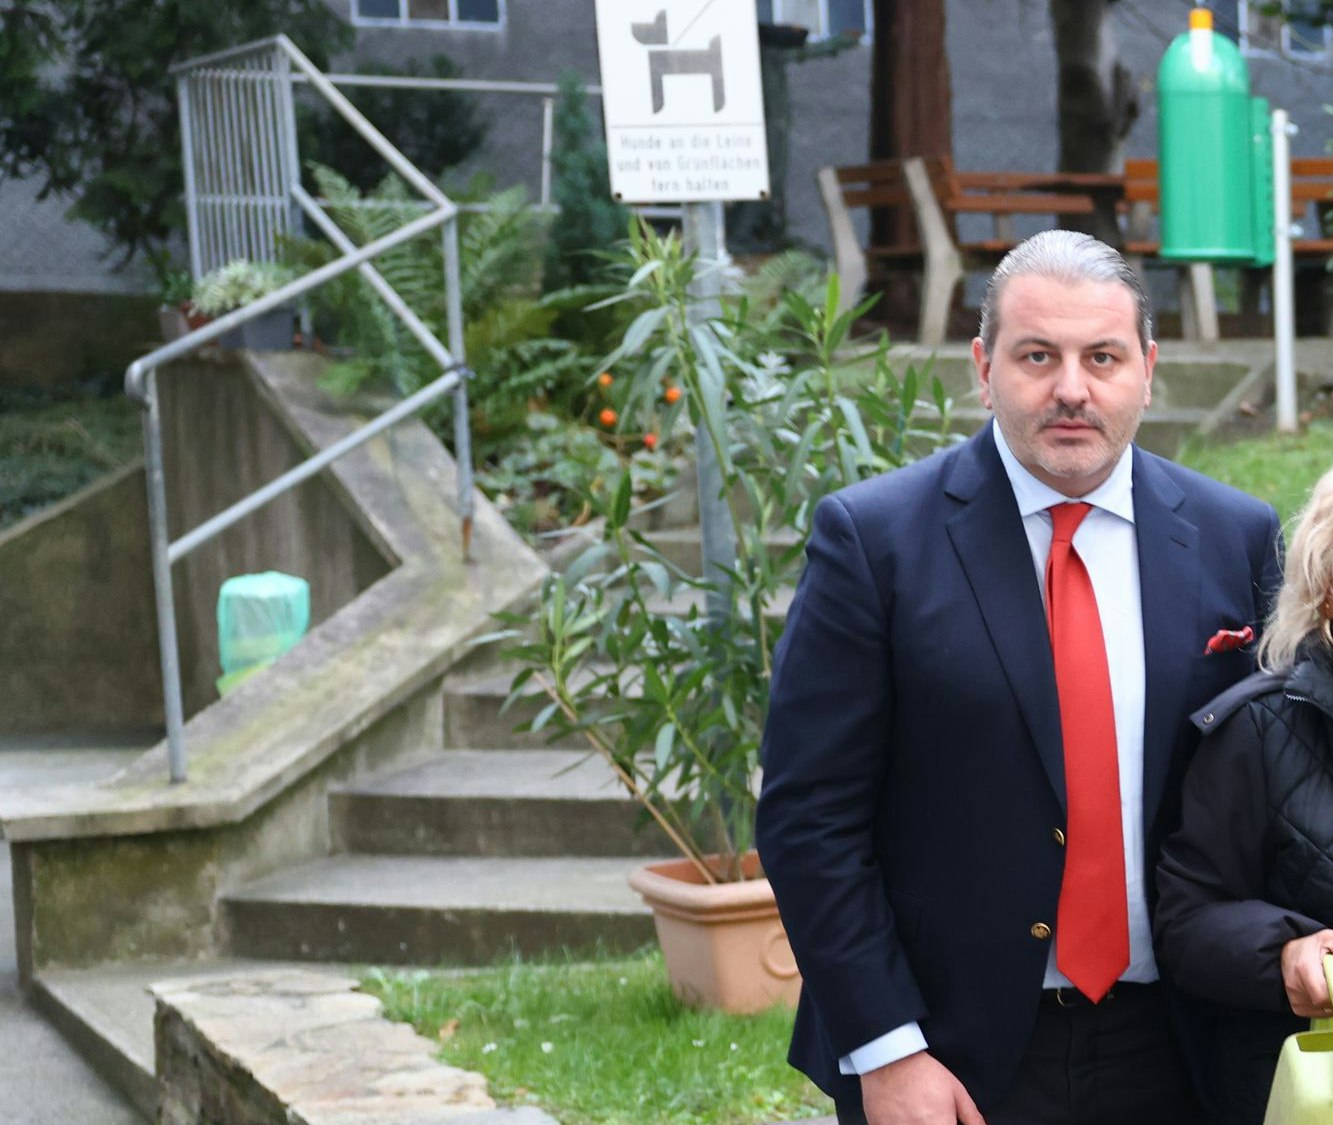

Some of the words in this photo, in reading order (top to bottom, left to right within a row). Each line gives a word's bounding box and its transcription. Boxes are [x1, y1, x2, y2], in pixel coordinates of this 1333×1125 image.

[620, 135, 661, 151] Hunde
[670, 138, 685, 150] an
[691, 134, 710, 149] die
[716, 134, 752, 149] Leine
[616, 156, 641, 172] und
[647, 160, 671, 171] von
[676, 155, 760, 171] Grünflächen
[652, 178, 680, 192] fern
[686, 176, 729, 192] halten
